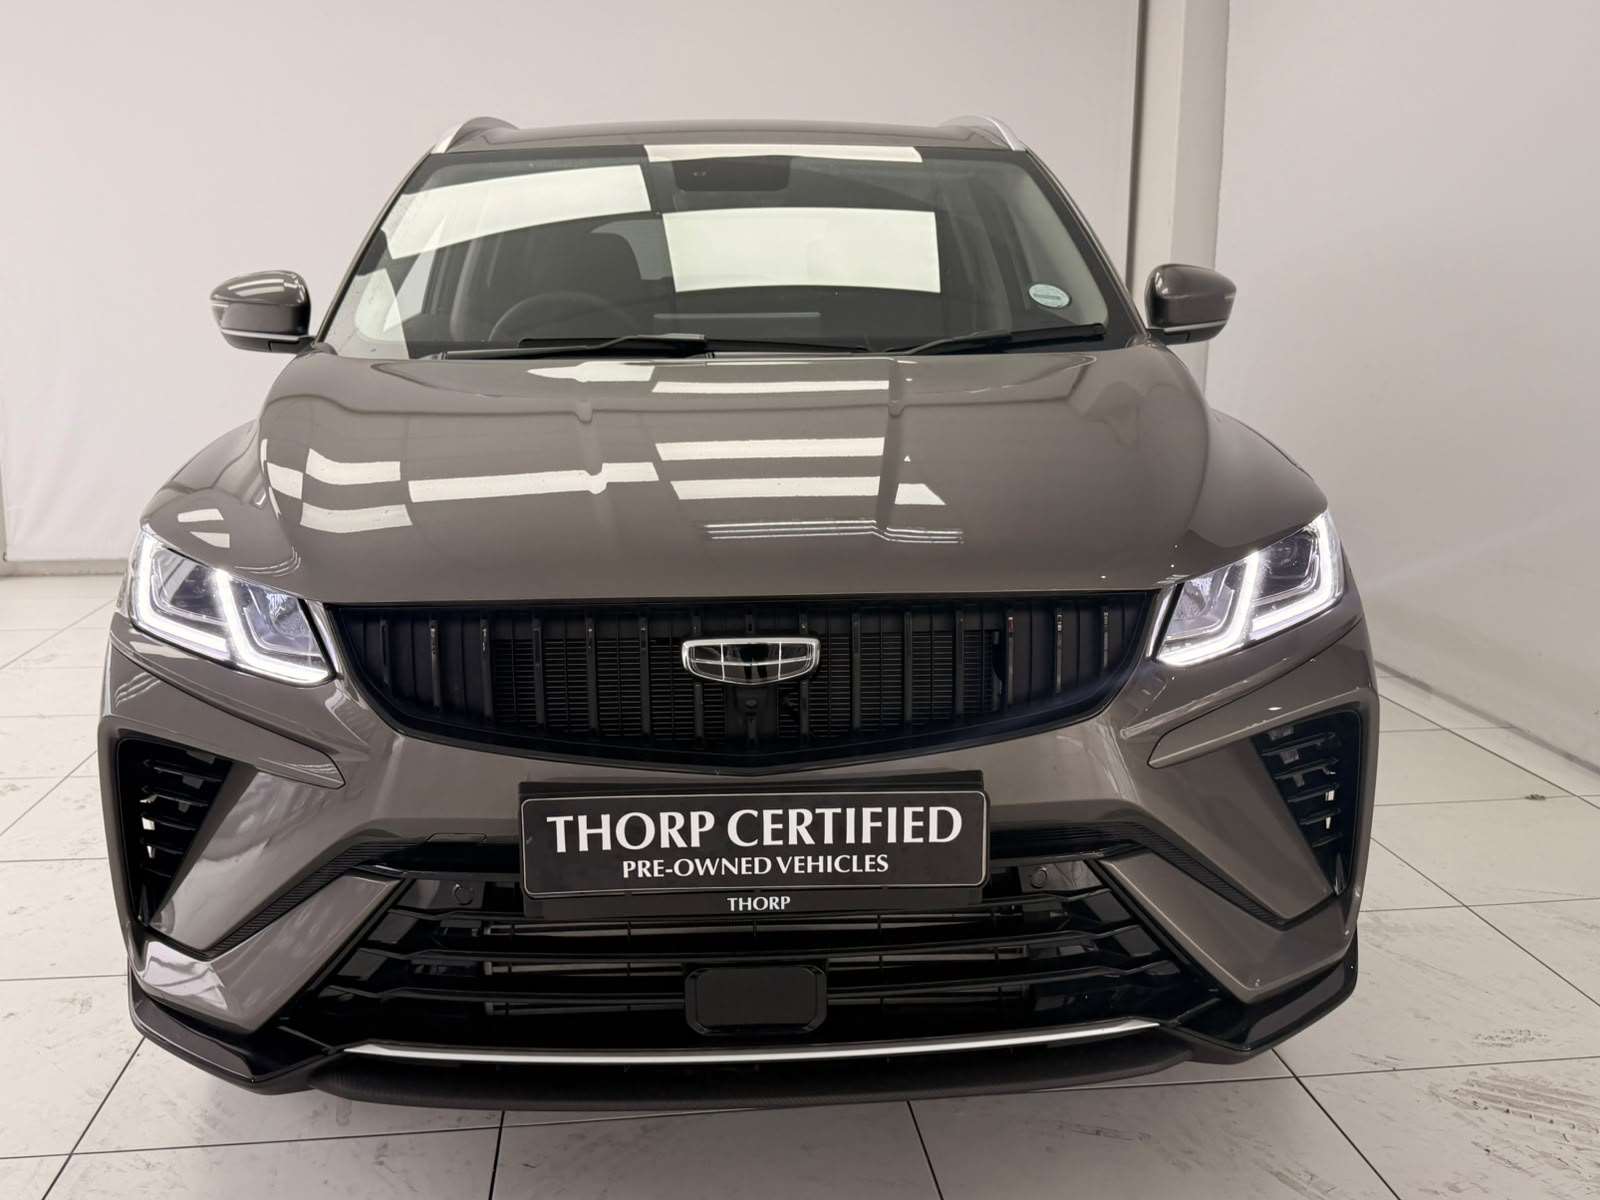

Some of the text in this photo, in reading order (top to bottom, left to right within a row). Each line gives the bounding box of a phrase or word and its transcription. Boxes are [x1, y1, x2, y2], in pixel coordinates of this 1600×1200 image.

[546, 806, 962, 853] THORP CERTIFIED
[622, 854, 889, 879] PRE-OWNED VEHICLES
[727, 896, 791, 911] THORP
